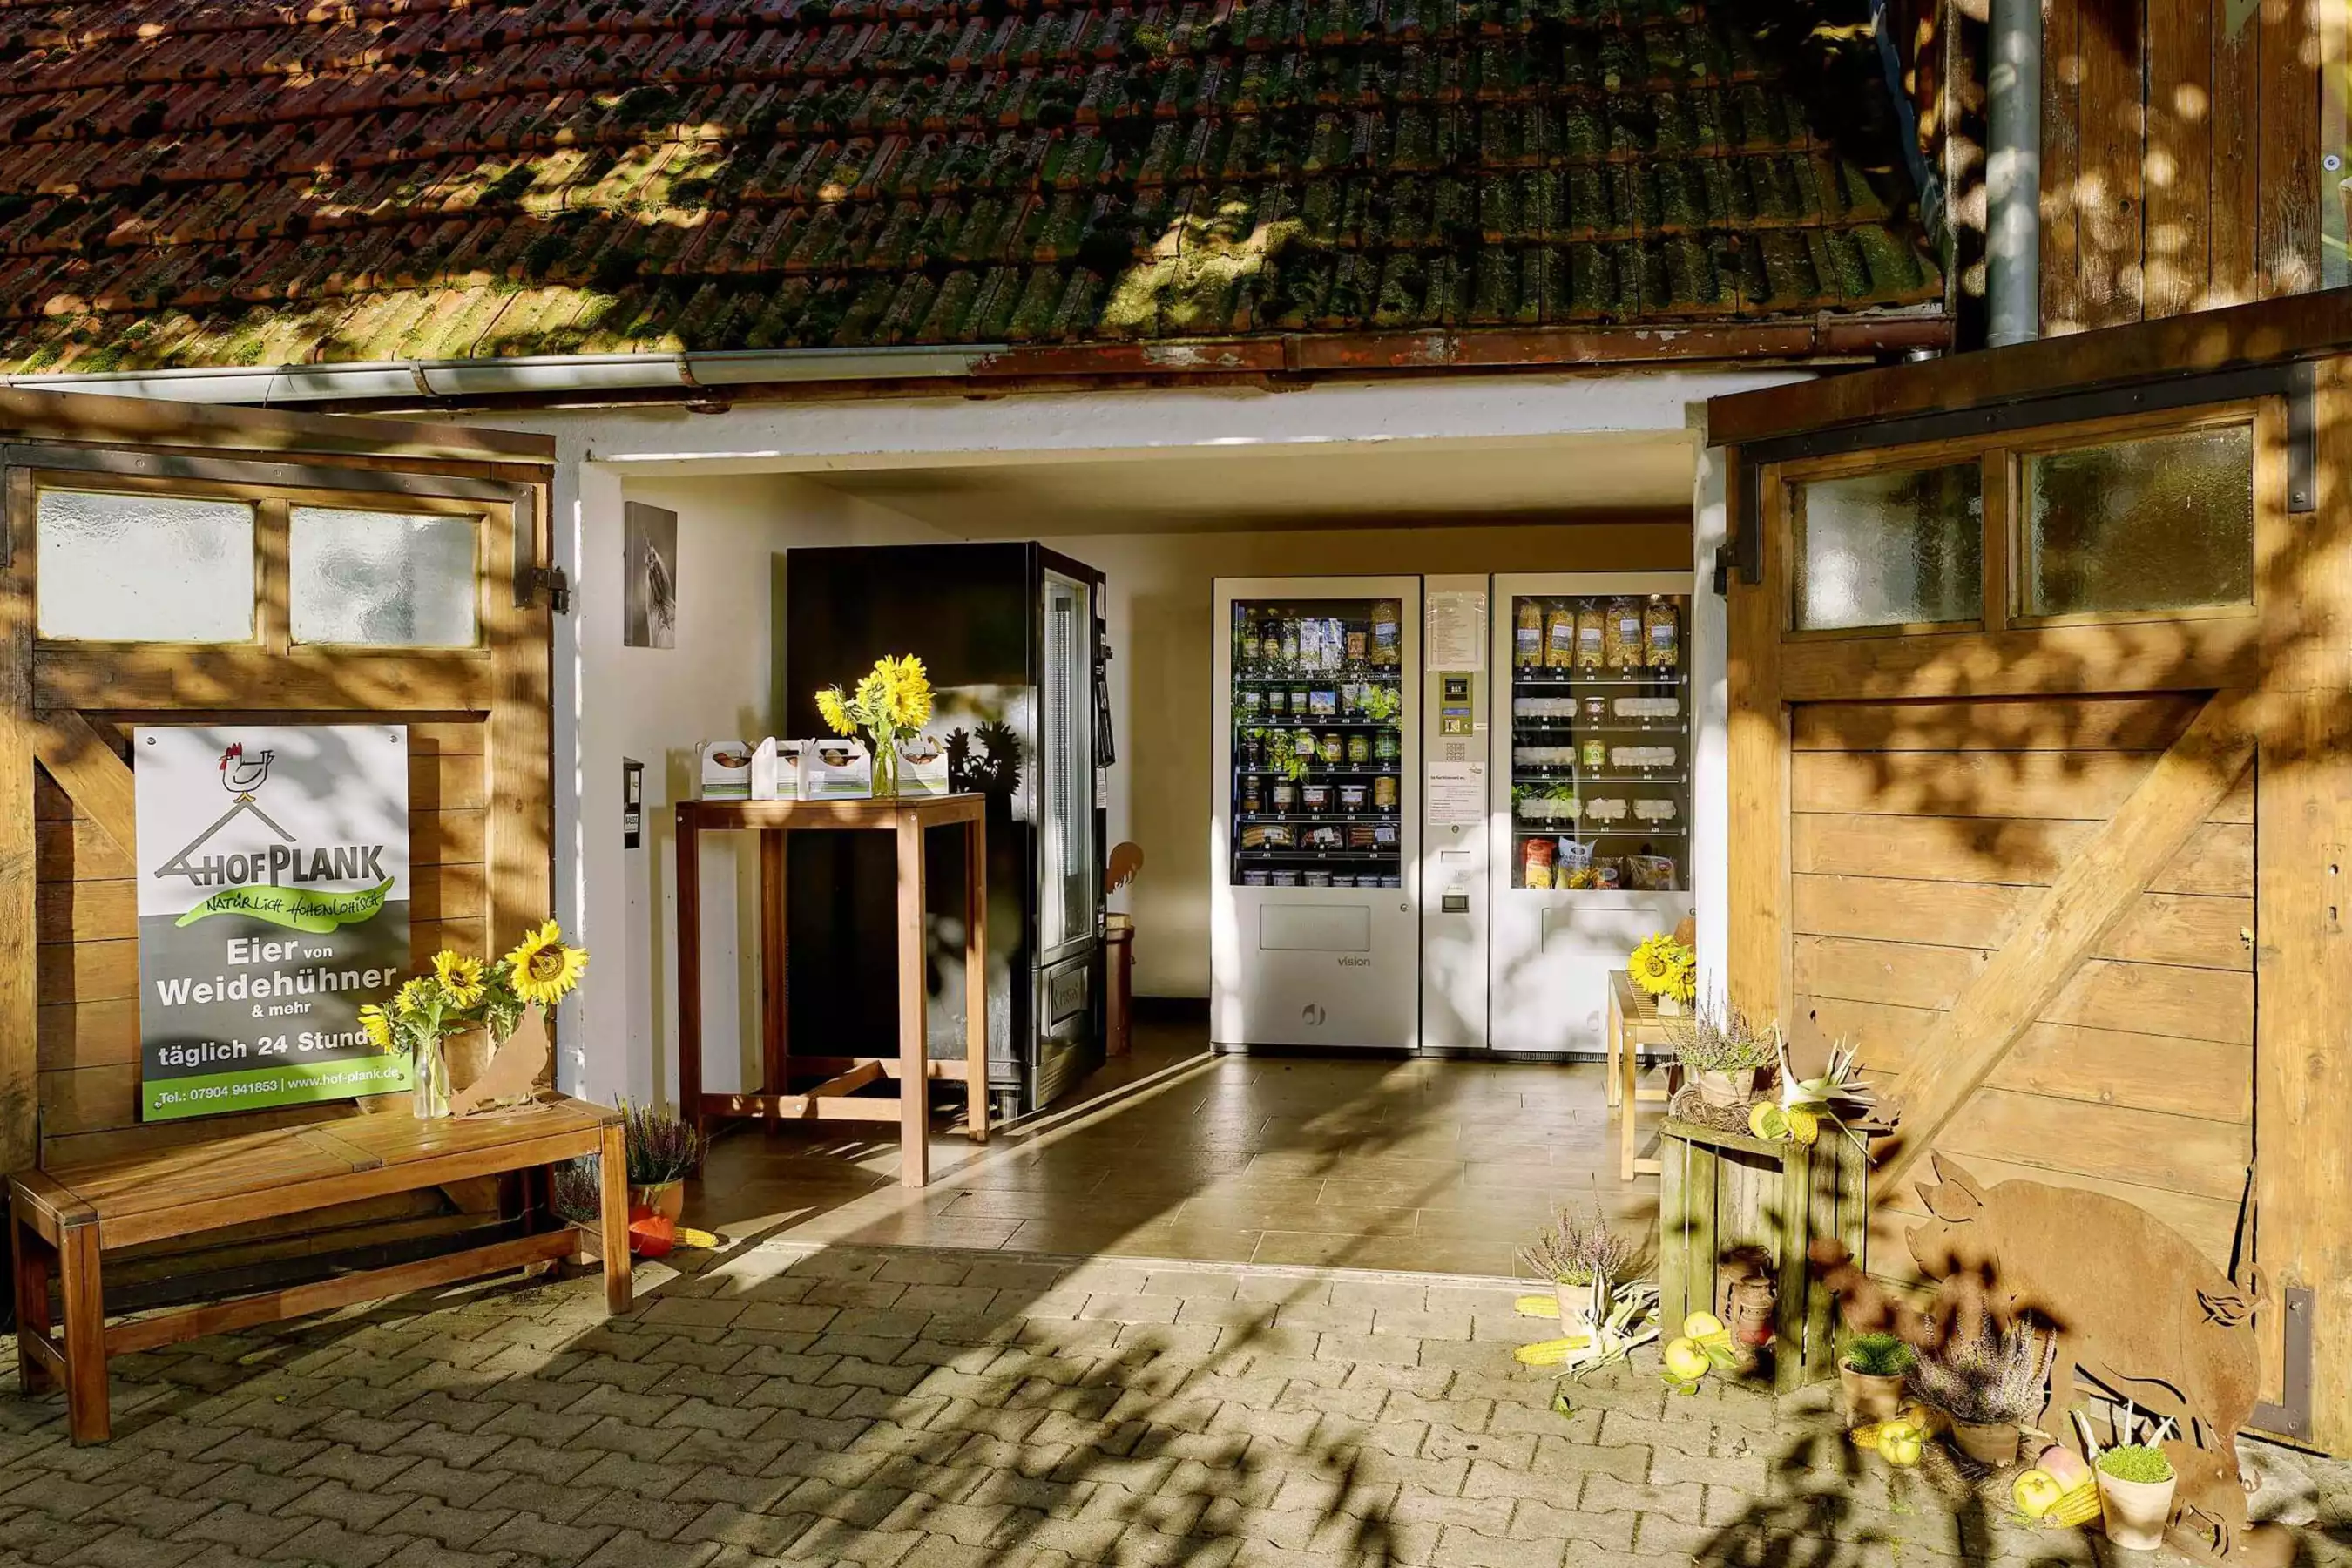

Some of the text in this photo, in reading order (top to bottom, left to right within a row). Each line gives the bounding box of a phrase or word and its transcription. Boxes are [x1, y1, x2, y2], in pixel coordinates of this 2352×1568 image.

[227, 937, 333, 965] Eier von
[1338, 956, 1370, 966] vision
[157, 966, 397, 1006] Weidehühner
[251, 1001, 311, 1017] & mehr
[158, 1029, 378, 1068] täglich 24 Stund
[159, 1067, 399, 1105] Tel.: 07904 941853 www.hof-plank.de
